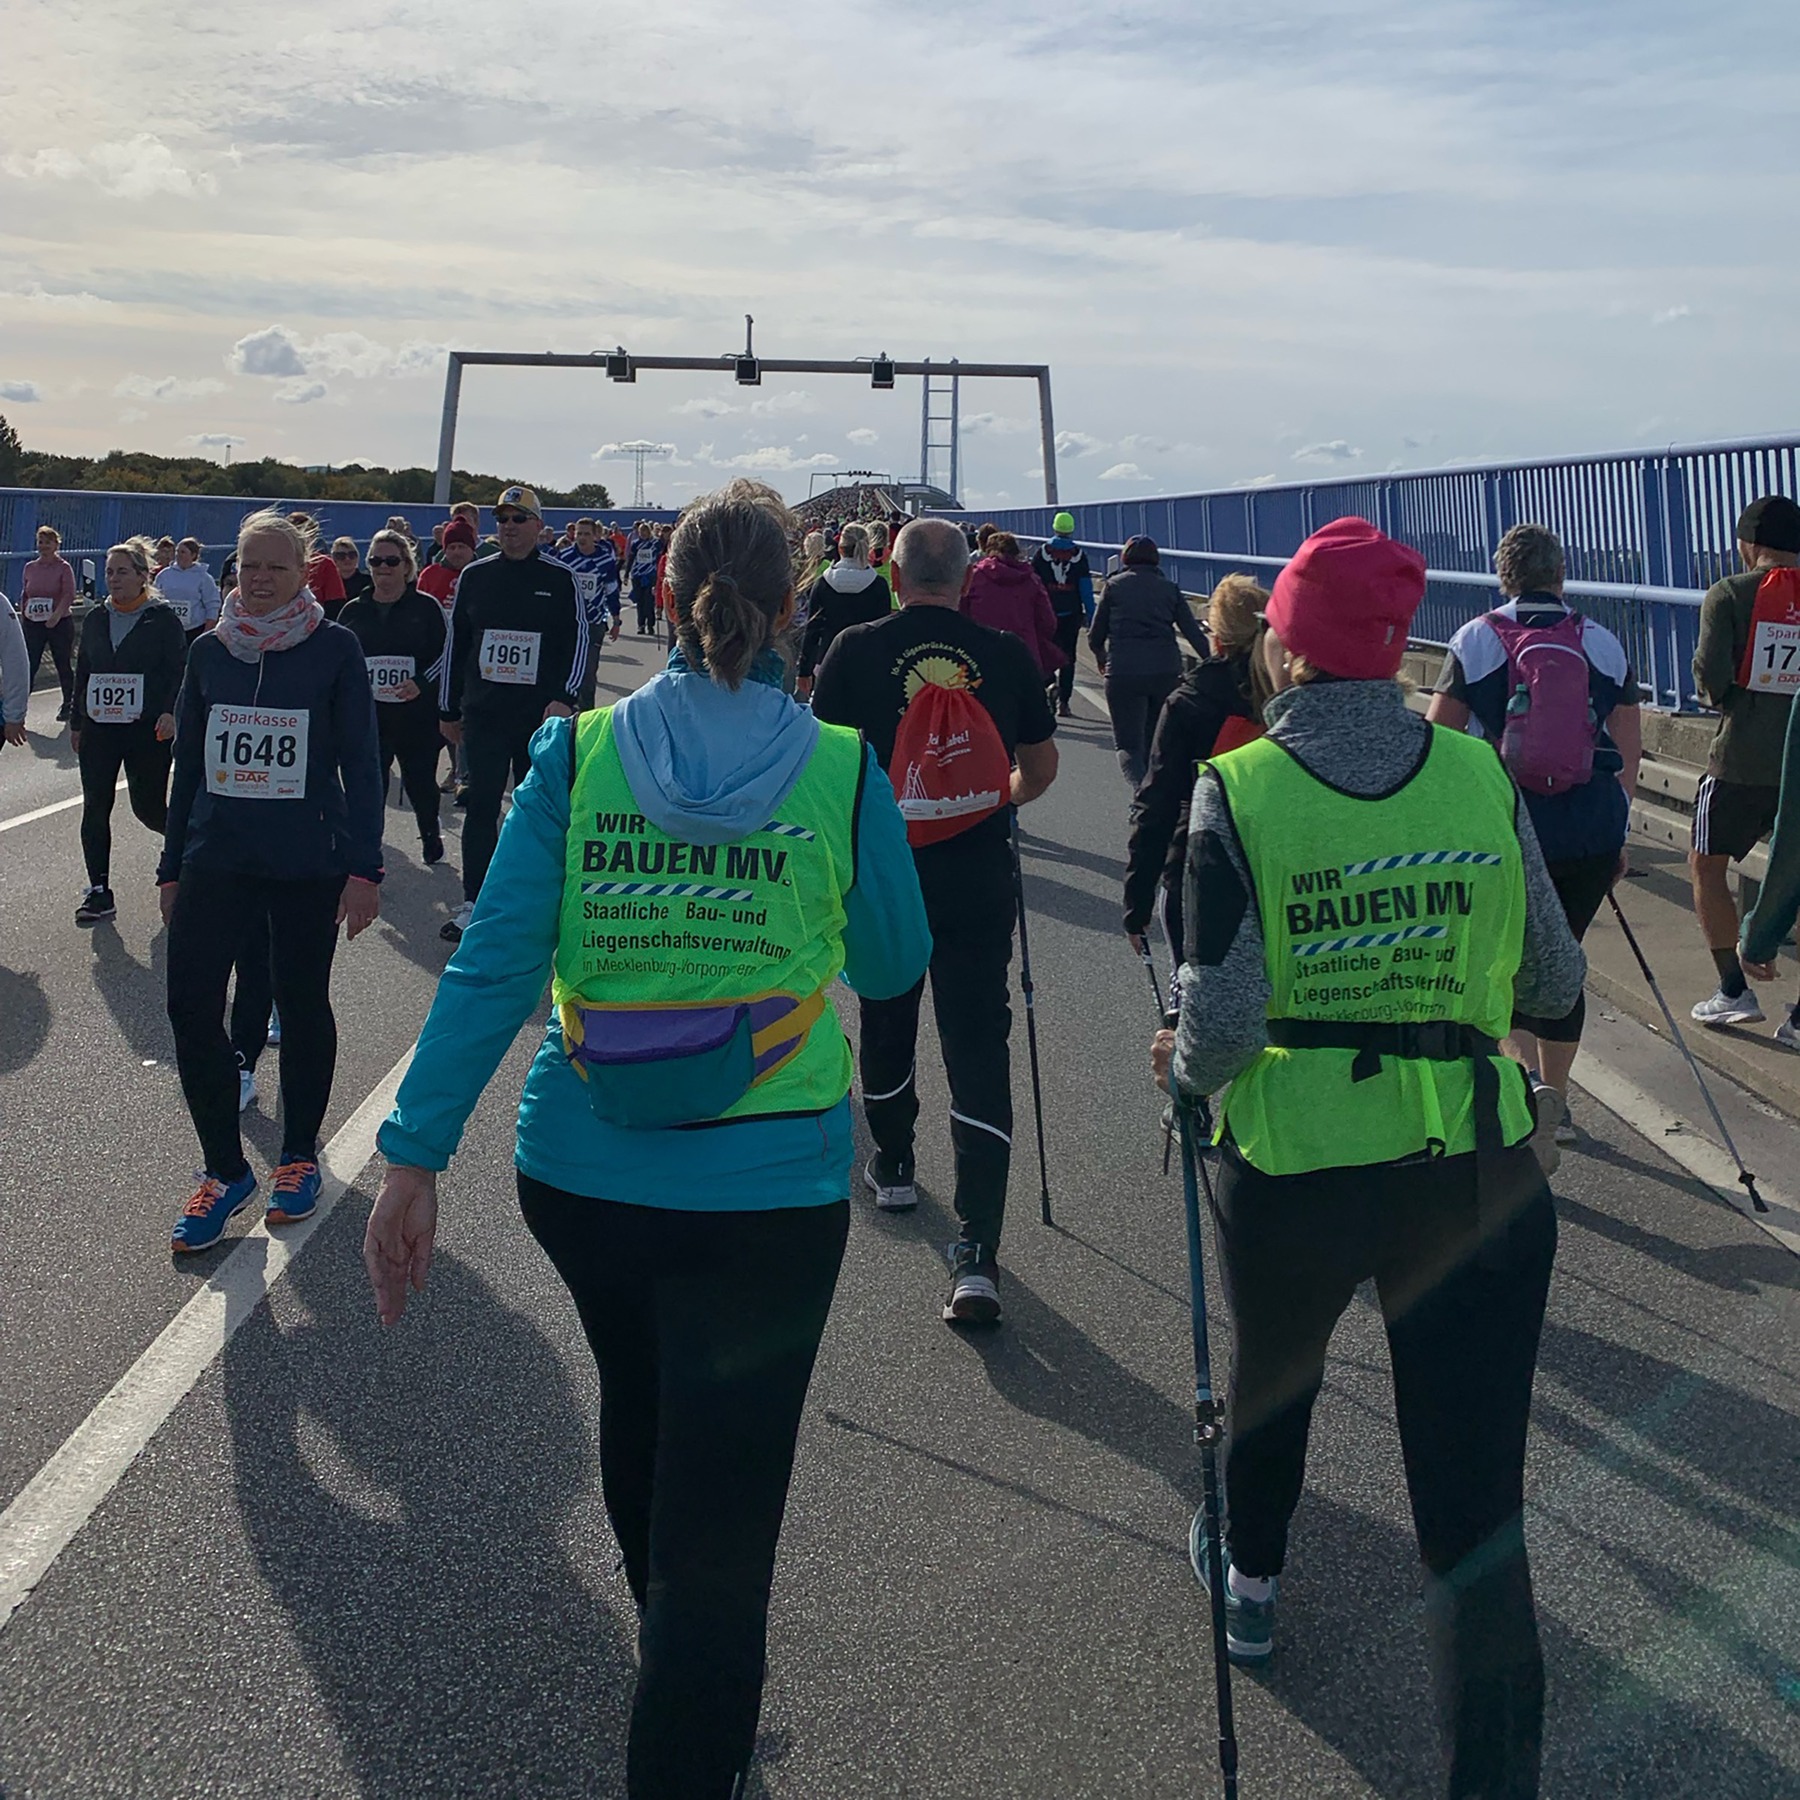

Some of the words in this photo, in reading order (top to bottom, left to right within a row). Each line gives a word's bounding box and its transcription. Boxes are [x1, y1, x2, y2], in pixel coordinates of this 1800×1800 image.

[490, 631, 535, 642] Sparkasse
[1767, 626, 1800, 640] Spar
[486, 644, 531, 666] 1961
[1763, 643, 1800, 672] 17
[92, 687, 135, 706] 1921
[220, 709, 298, 728] Sparkasse
[215, 730, 297, 768] 1648
[234, 769, 270, 783] DAK
[595, 811, 646, 834] WIR
[582, 840, 717, 875] BAUEN
[1292, 868, 1342, 895] WIR
[583, 901, 669, 920] Staatliche
[686, 902, 726, 921] Bau-
[732, 908, 767, 926] und
[1286, 885, 1417, 935] BAUEN
